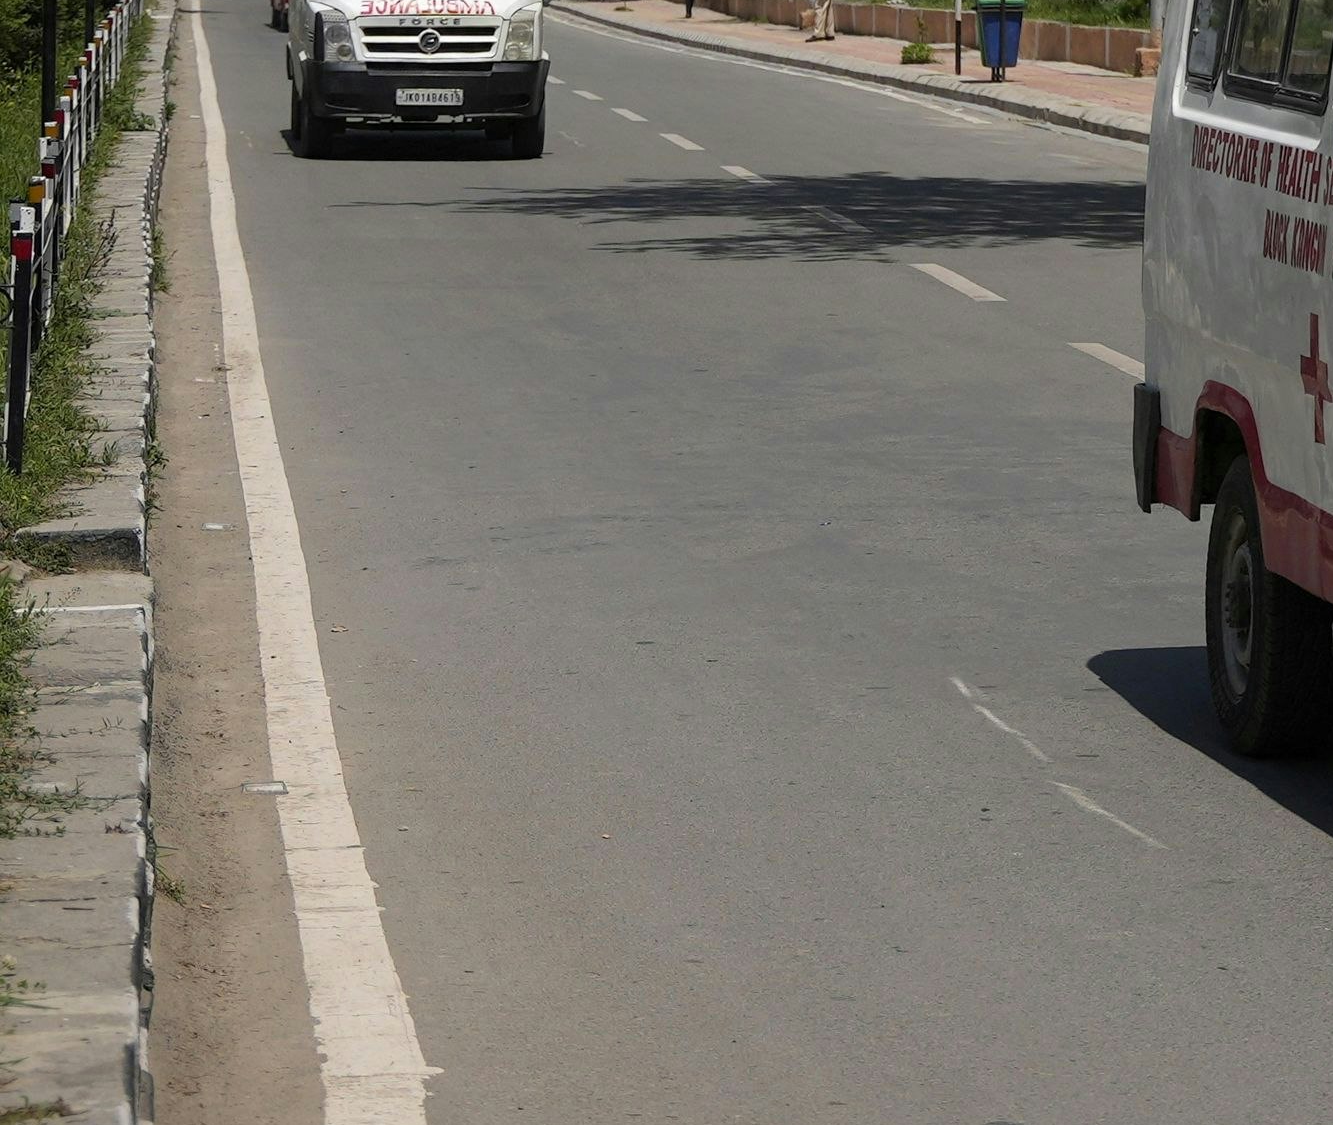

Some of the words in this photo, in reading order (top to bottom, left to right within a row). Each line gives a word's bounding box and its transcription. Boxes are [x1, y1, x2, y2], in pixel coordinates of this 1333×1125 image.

[399, 18, 461, 26] FORCE
[1192, 124, 1259, 184] DIRECTORATE
[1260, 141, 1274, 188] OF
[1275, 144, 1323, 203] HEALTH
